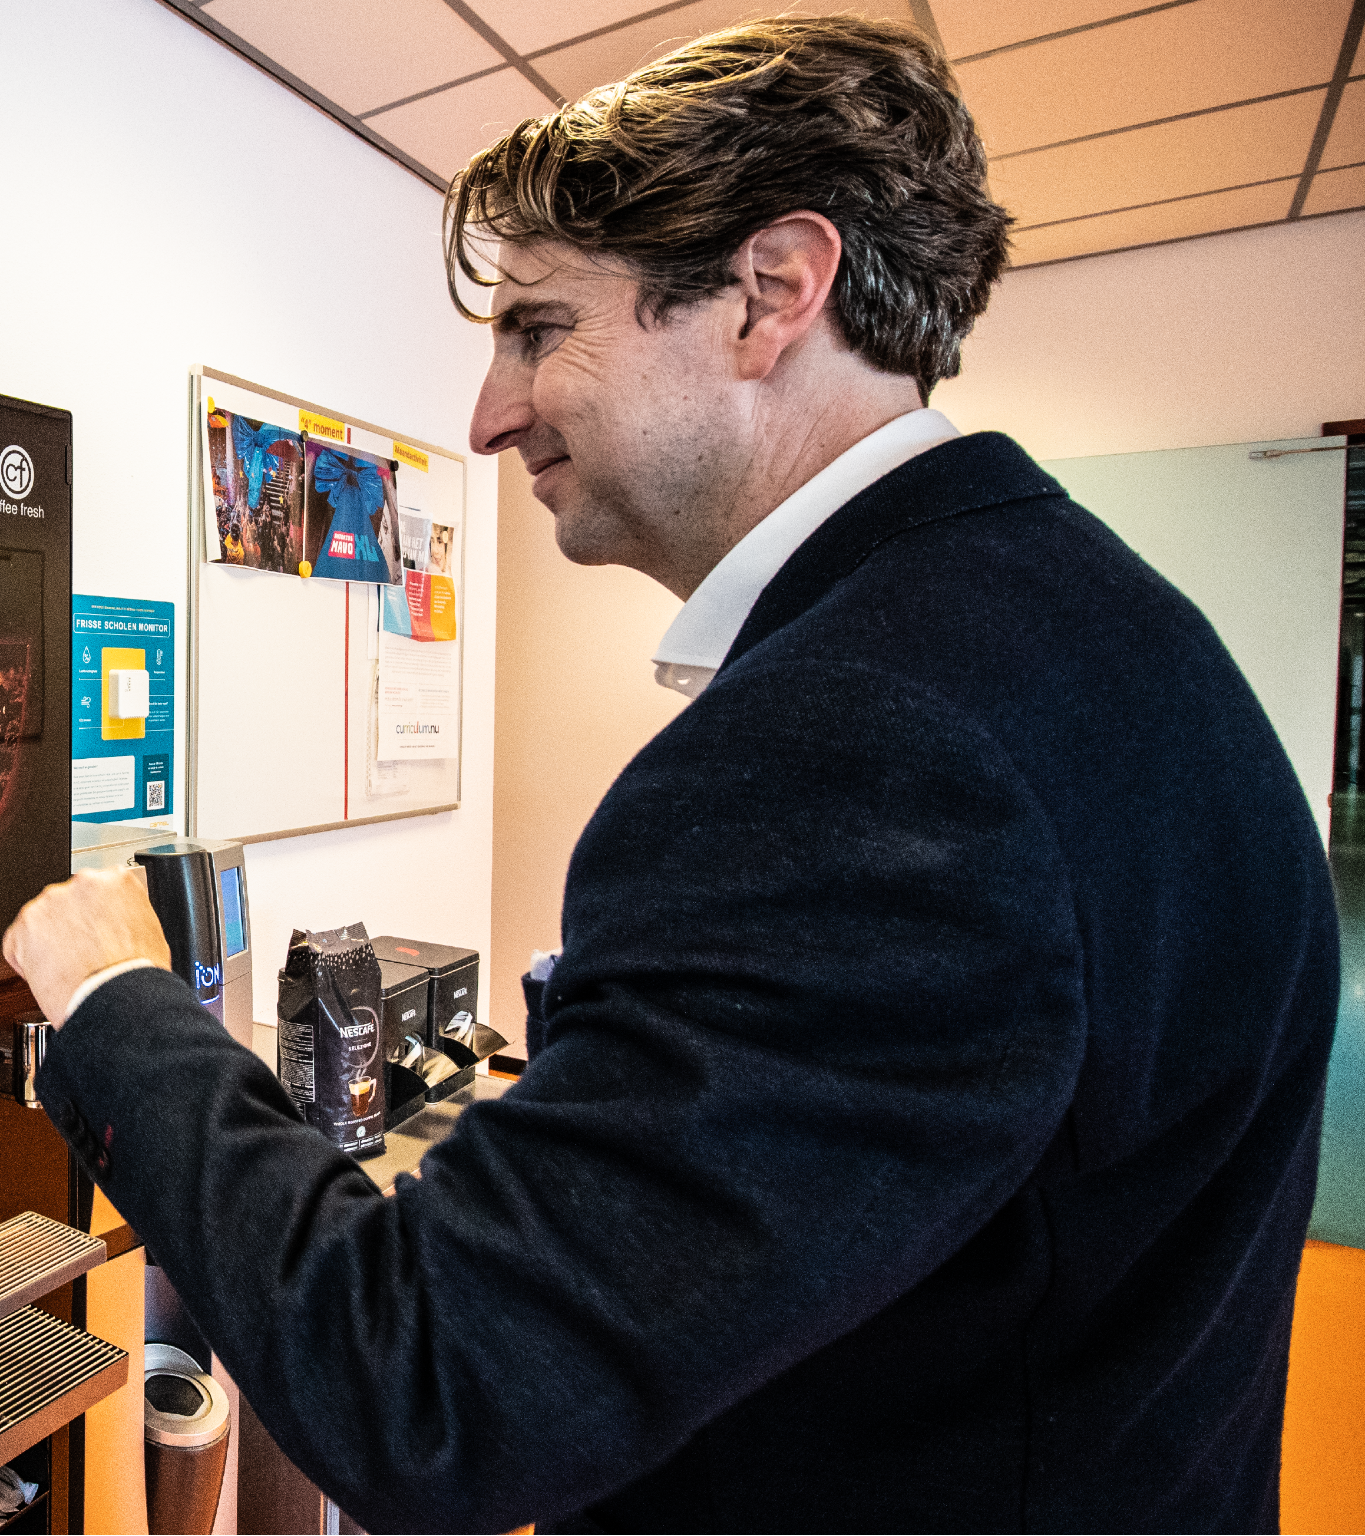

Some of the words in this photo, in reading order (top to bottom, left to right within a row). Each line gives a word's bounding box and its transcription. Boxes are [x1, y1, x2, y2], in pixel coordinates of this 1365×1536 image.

[313, 423, 343, 440] moment
[20, 503, 45, 518] fresh
[330, 540, 354, 555] MAVO
[76, 619, 102, 629] FRISSE
[104, 621, 137, 631] SCHOLEN
[138, 623, 168, 633] MONITOR
